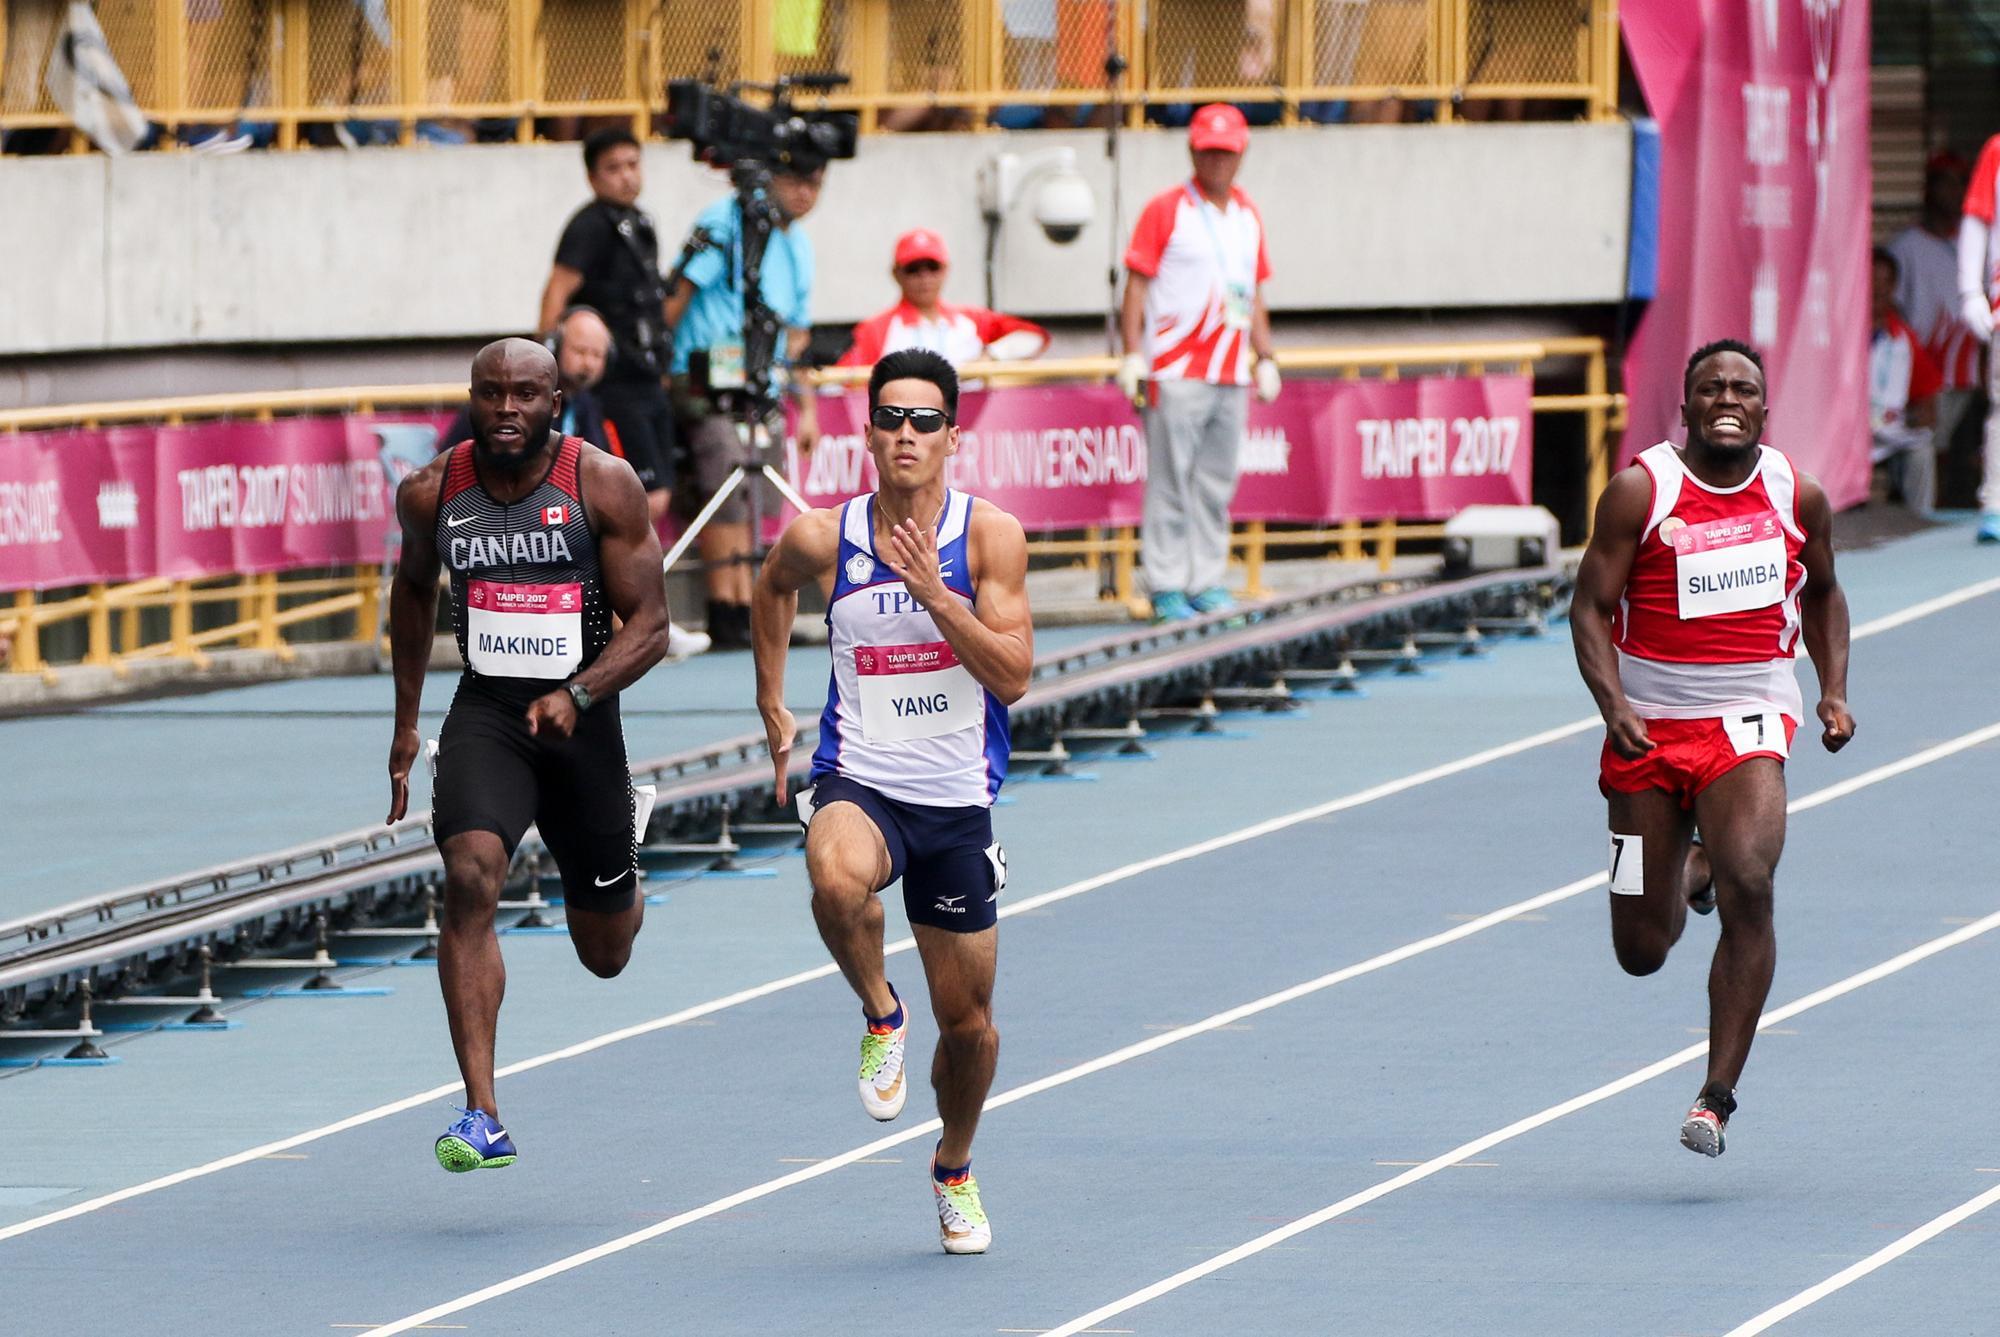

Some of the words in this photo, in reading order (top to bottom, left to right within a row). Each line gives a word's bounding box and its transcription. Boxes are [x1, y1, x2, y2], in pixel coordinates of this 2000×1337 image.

[1356, 417, 1446, 479] TAIPEI
[1452, 416, 1520, 477] 2017
[805, 434, 865, 496] 2017
[177, 464, 238, 532] TAIPEI
[239, 464, 288, 528] 2017
[290, 460, 385, 525] SUMMER
[1704, 528, 1731, 539] TAIPEI
[1732, 523, 1752, 535] 2017
[450, 530, 573, 571] CANADA
[1688, 563, 1779, 594] SILWIMBA
[496, 592, 525, 602] TAIPEI
[527, 594, 548, 603] 2017
[479, 633, 567, 656] MAKINDE
[887, 653, 915, 663] TAIPEI
[918, 651, 939, 661] 2017
[891, 693, 949, 717] YANG
[1742, 714, 1763, 745] 7
[1612, 836, 1624, 884] 7
